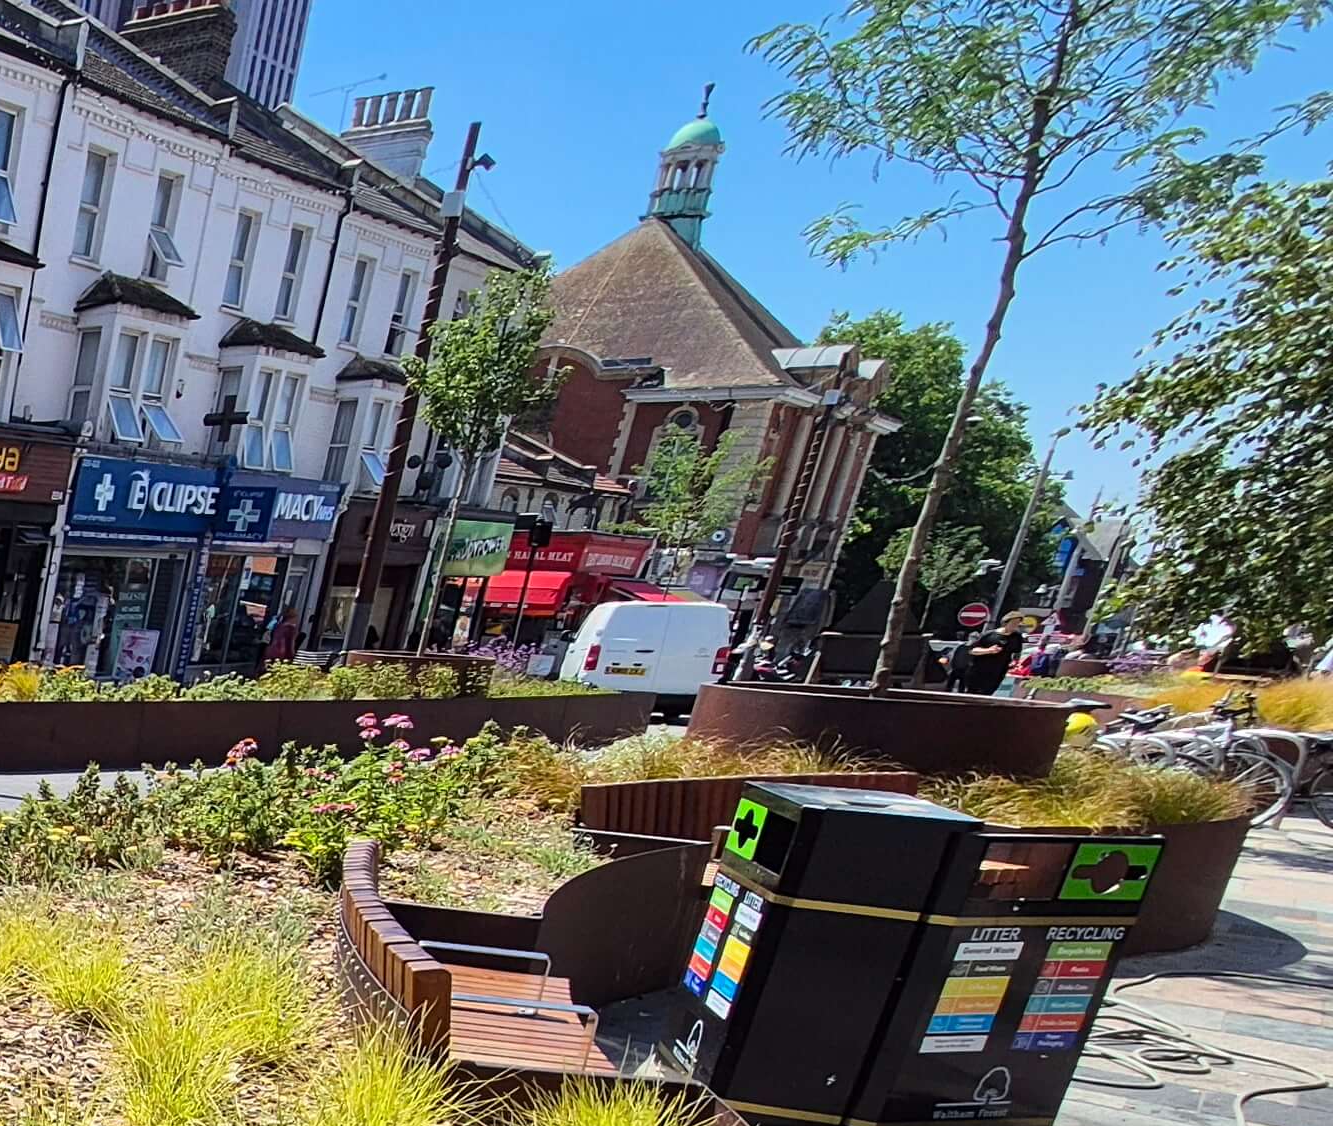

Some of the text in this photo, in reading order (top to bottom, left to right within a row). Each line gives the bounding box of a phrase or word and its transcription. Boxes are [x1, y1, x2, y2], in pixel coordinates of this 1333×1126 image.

[274, 493, 324, 522] MACY
[389, 518, 416, 543] esign
[547, 551, 574, 563] MEAT
[970, 927, 1021, 941] LITTER
[1046, 927, 1126, 941] RECYCLING
